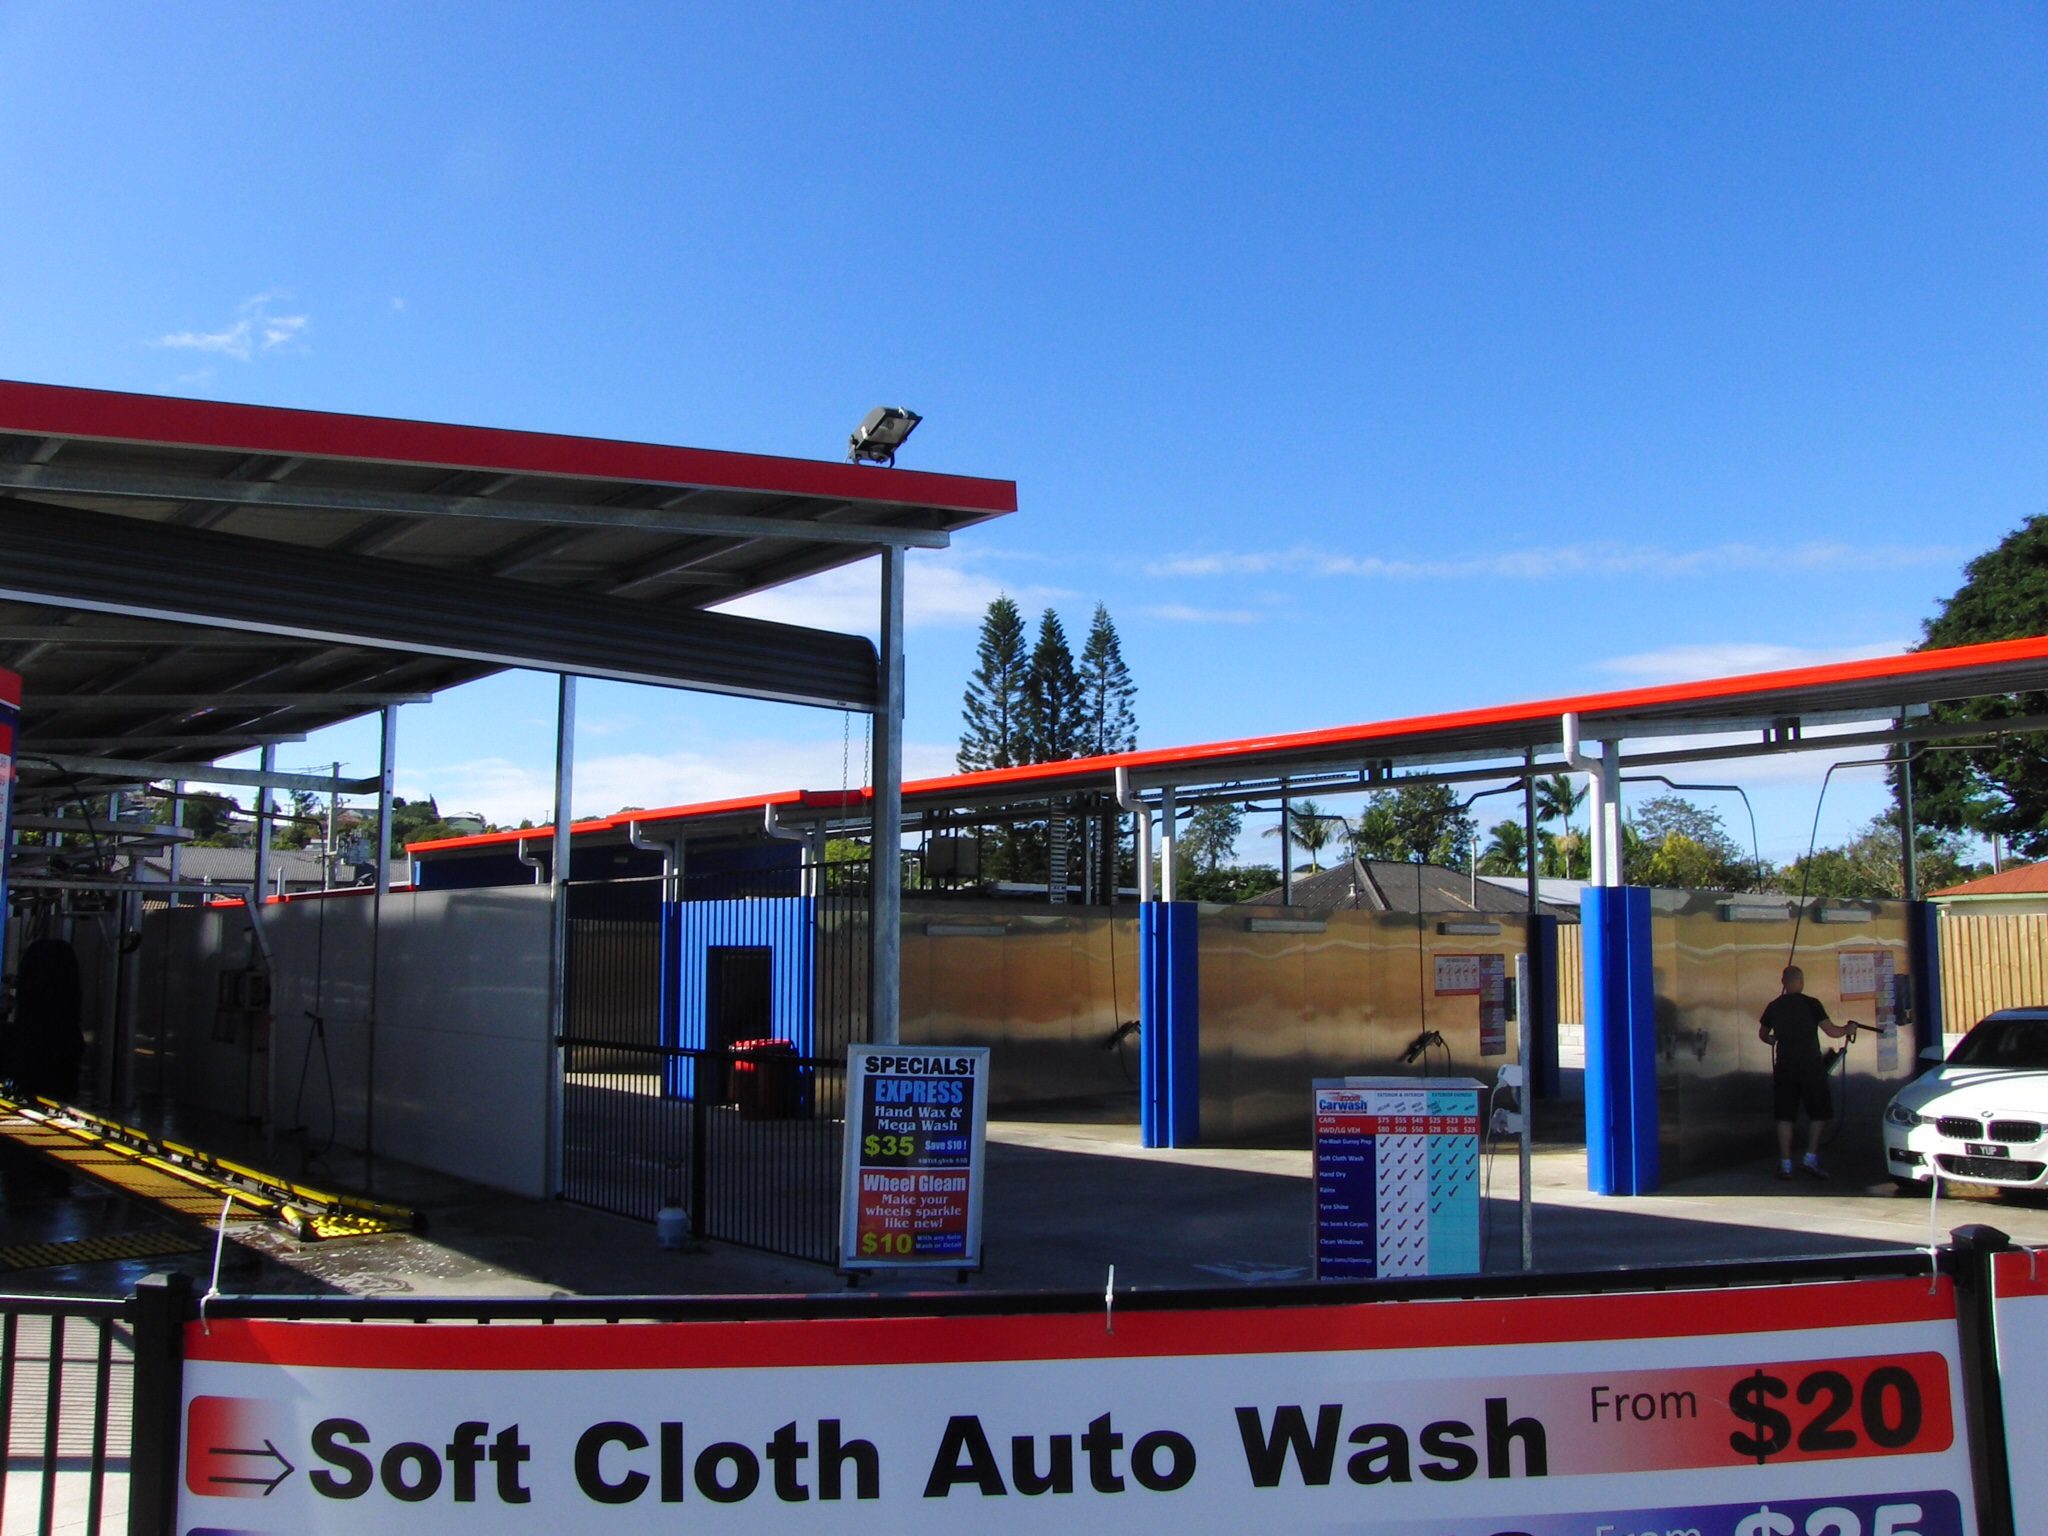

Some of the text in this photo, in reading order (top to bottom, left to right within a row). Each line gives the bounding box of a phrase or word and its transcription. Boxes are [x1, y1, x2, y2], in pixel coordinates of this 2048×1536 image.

[865, 1056, 976, 1075] SPECIALS!
[875, 1079, 964, 1104] EXPRESS
[875, 1106, 963, 1118] Hand Wax &
[1319, 1100, 1367, 1110] Carwash
[878, 1119, 958, 1133] Mega Wash
[1429, 1116, 1440, 1124] $25
[1464, 1116, 1476, 1124] $20
[864, 1135, 915, 1157] $35
[925, 1140, 946, 1150] Save
[1980, 1145, 1997, 1155] YUP
[863, 1174, 966, 1192] Wheel Gleam
[882, 1194, 949, 1208] Make your
[866, 1205, 962, 1218] wheels sparkle
[885, 1217, 943, 1228] like new!
[862, 1232, 912, 1255] $10
[1590, 1366, 1923, 1466] From $20
[308, 1397, 1549, 1504] Soft Cloth Auto Wash
